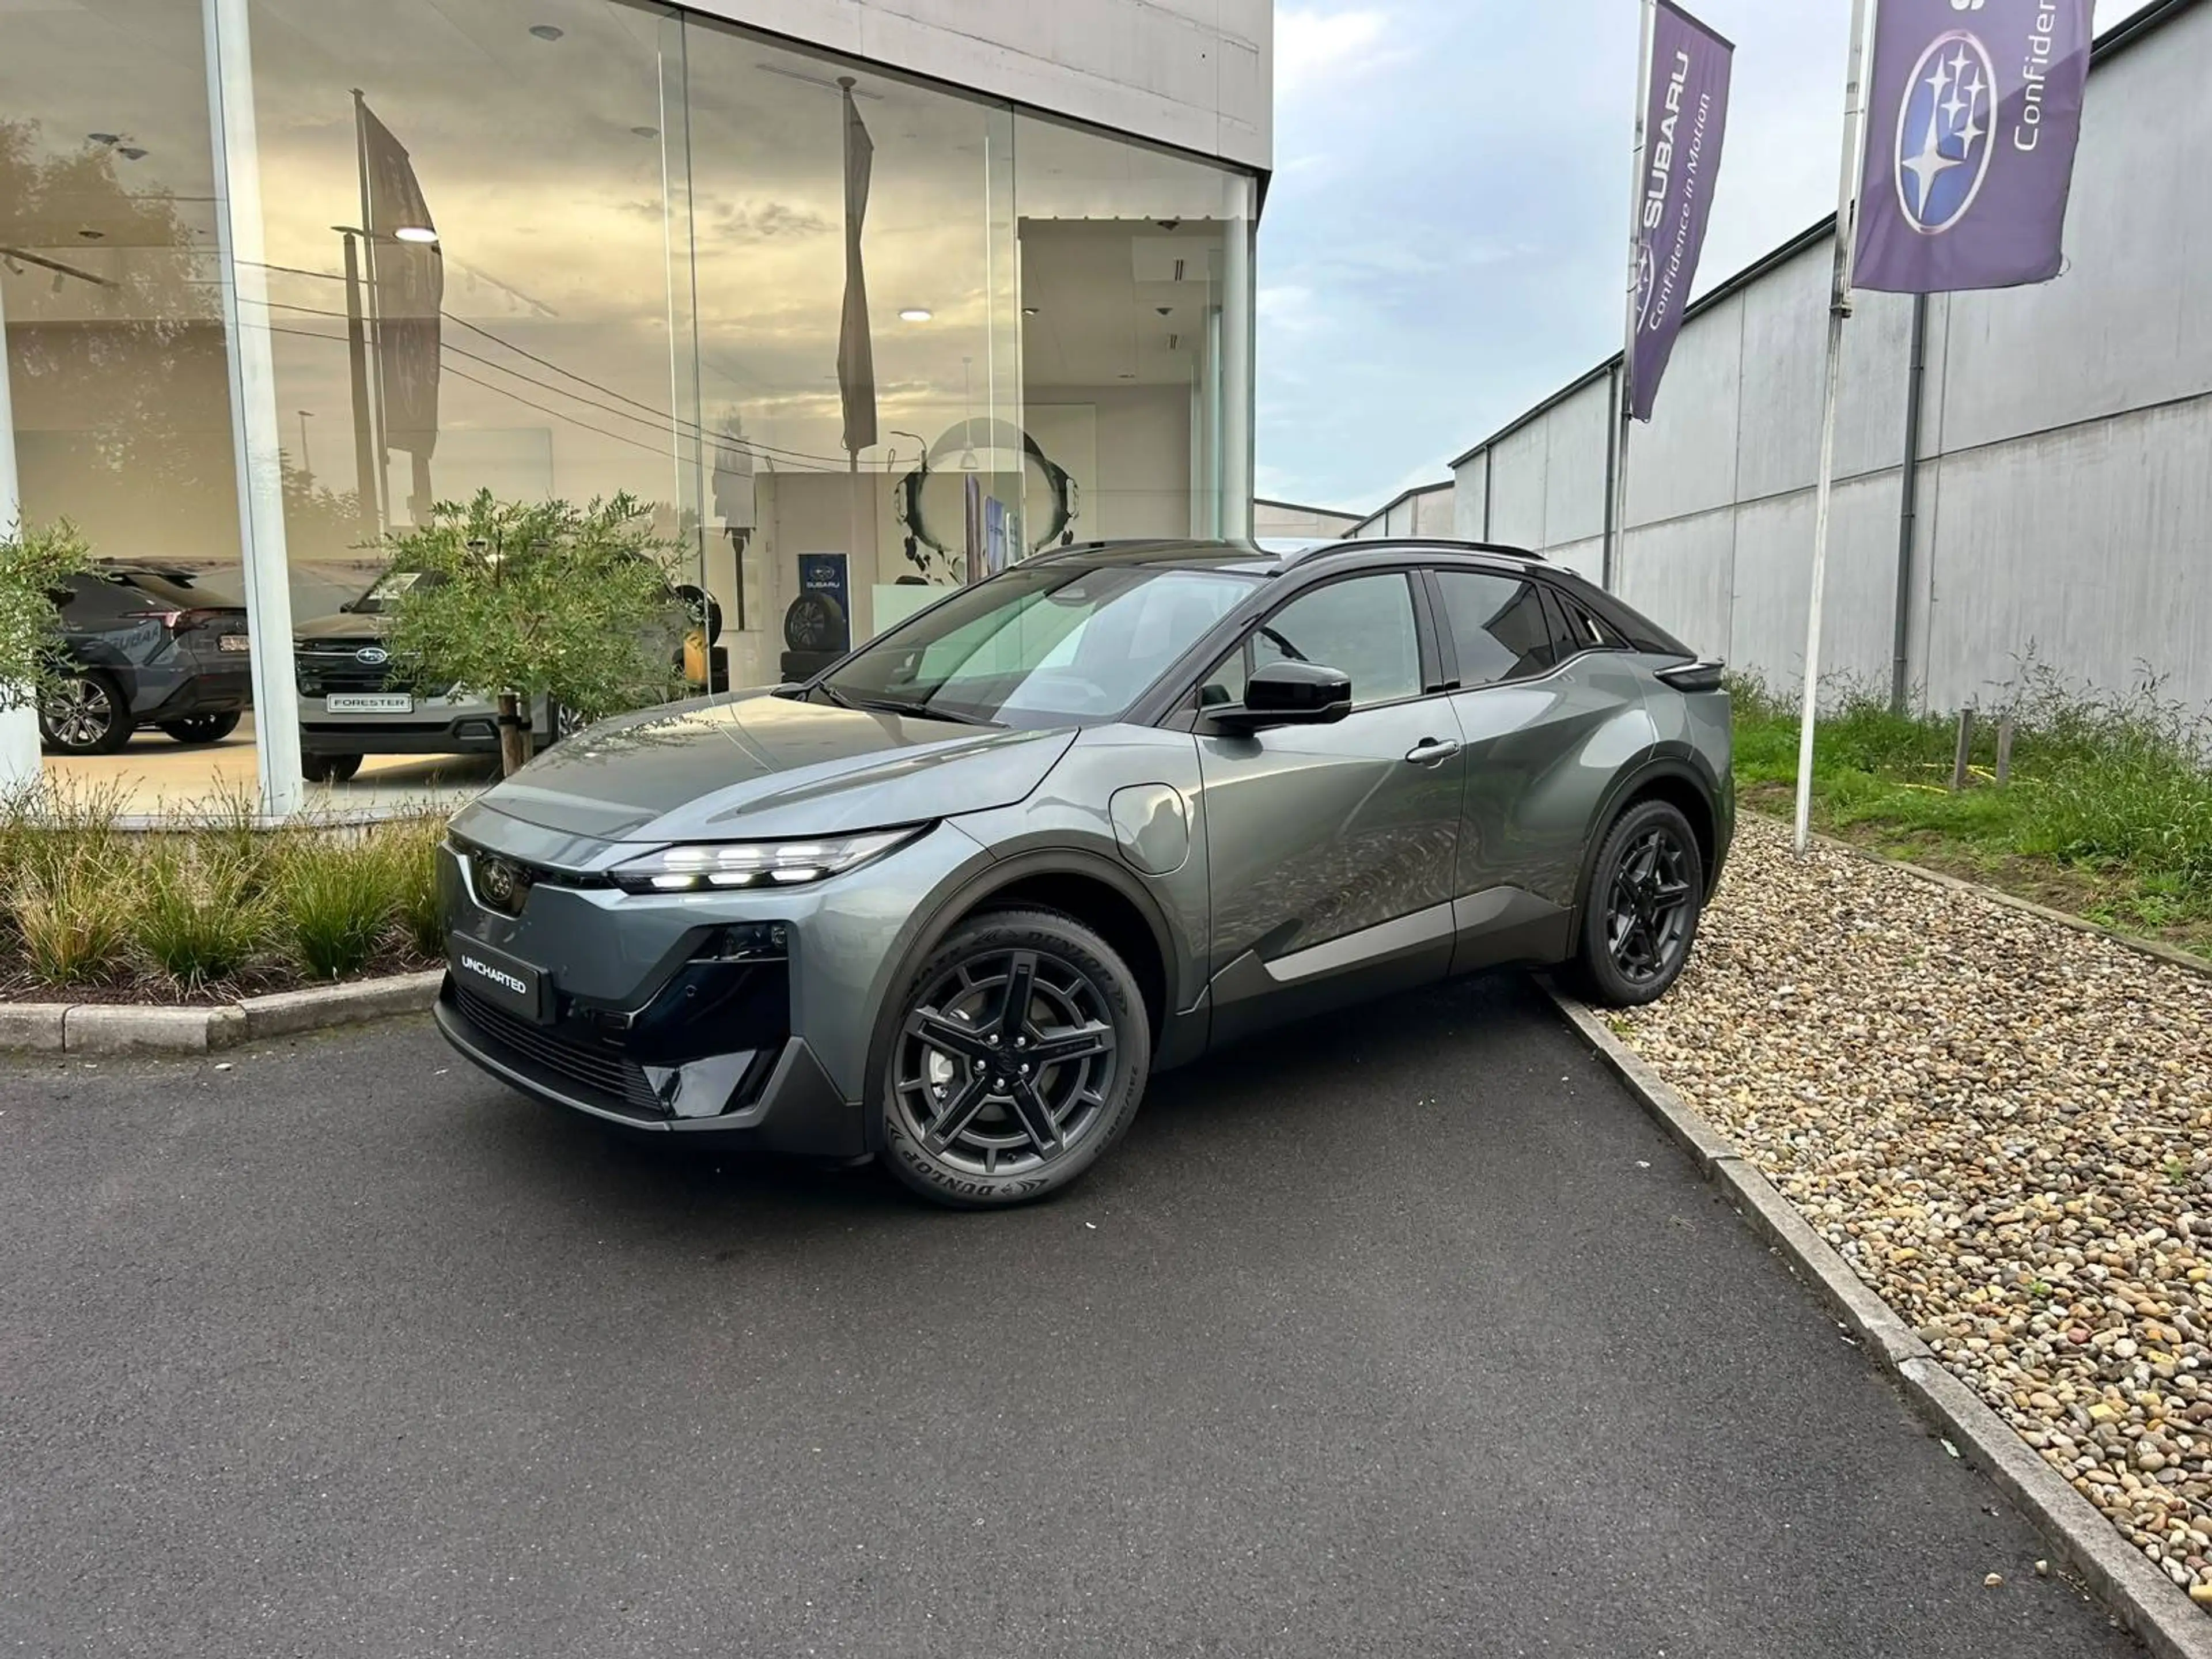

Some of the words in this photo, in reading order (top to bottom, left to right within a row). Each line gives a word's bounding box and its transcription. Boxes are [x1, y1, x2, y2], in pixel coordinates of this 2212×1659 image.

[1643, 50, 1689, 229] SUBARU
[1687, 93, 1710, 175] Motion
[1682, 177, 1695, 199] in
[1649, 202, 1691, 331] Confidence
[334, 699, 405, 707] FORESTER
[461, 954, 527, 994] UNCHARTED
[903, 1150, 996, 1196] DUNLOP
